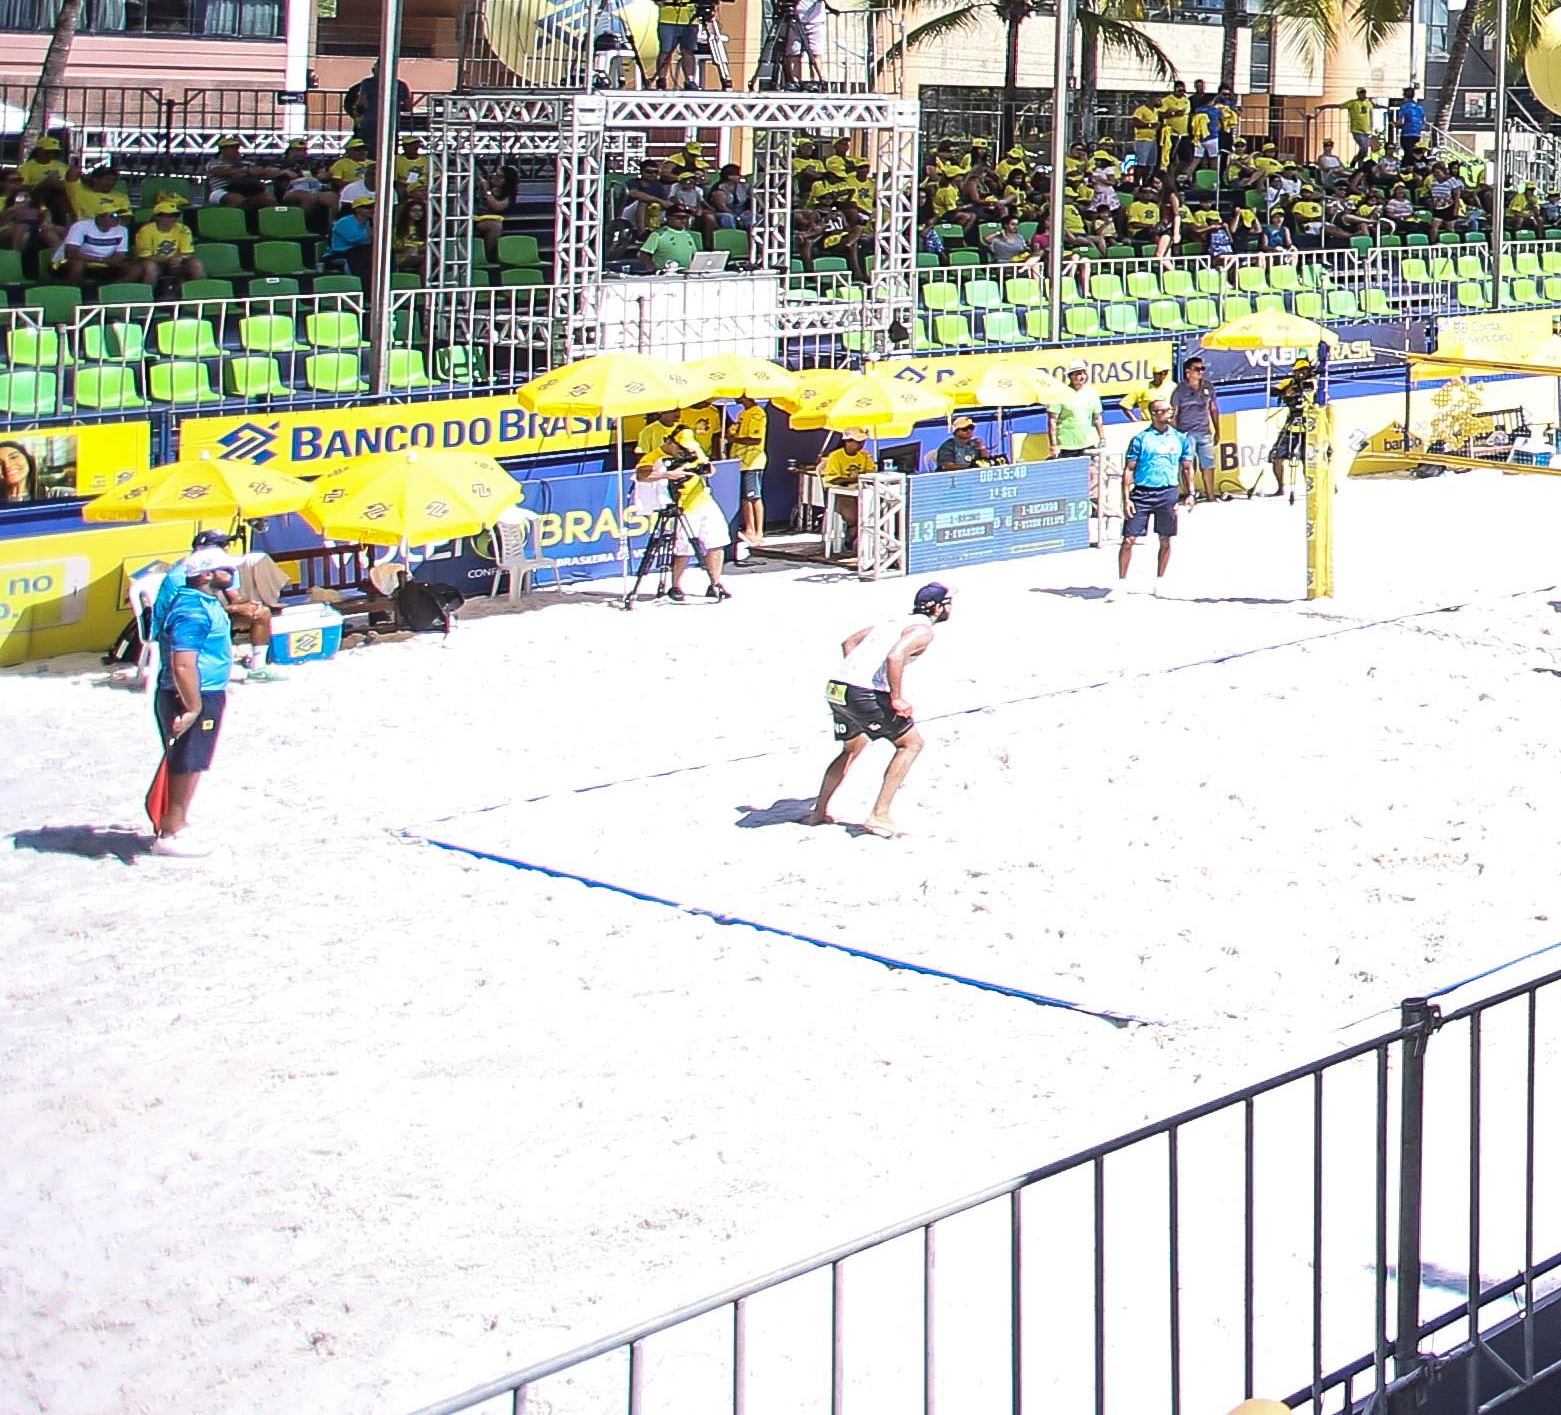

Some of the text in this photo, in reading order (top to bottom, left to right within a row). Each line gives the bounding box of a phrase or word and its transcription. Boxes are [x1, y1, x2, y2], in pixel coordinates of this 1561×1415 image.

[291, 421, 435, 462] BANCO
[442, 416, 492, 448] DO
[1067, 500, 1089, 522] 12
[911, 521, 935, 543] 13
[8, 574, 54, 596] no
